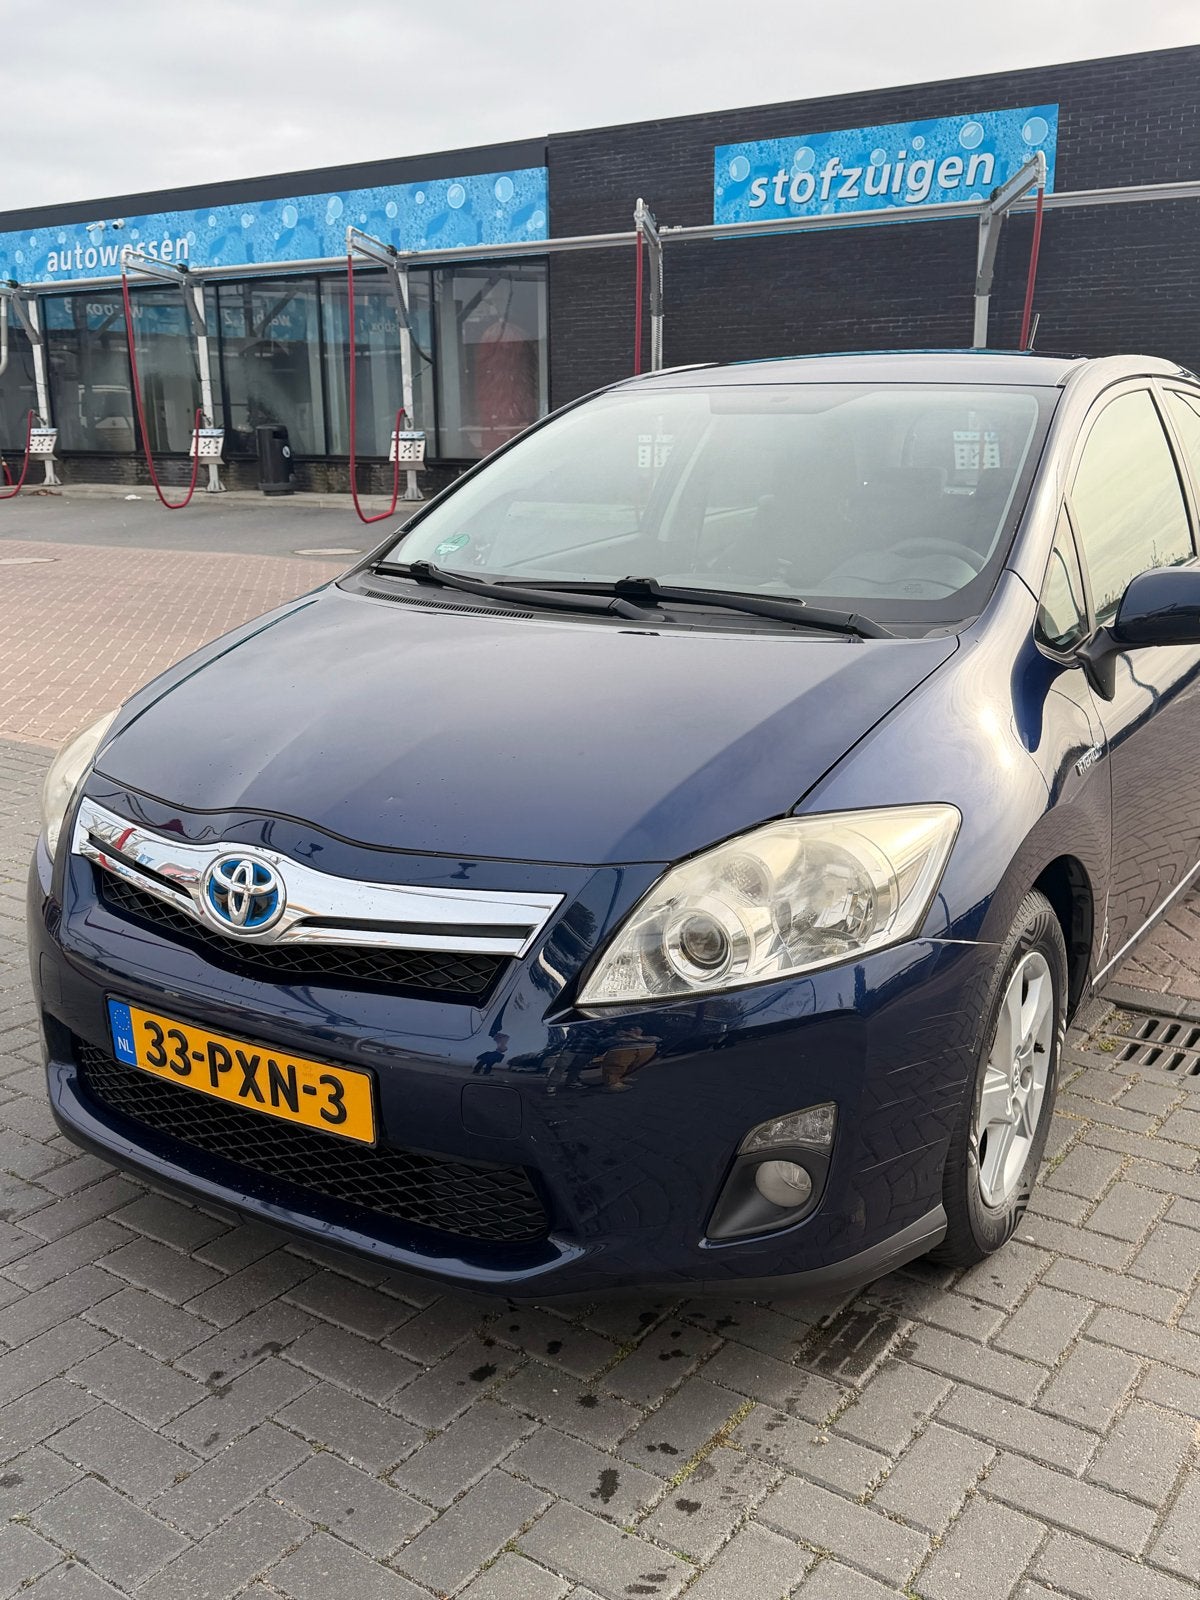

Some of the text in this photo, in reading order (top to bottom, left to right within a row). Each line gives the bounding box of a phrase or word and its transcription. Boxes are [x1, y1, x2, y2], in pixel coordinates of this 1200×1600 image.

[749, 151, 995, 208] stofzuigen
[117, 1036, 133, 1054] NL
[143, 1020, 348, 1125] 33-PXN-3
